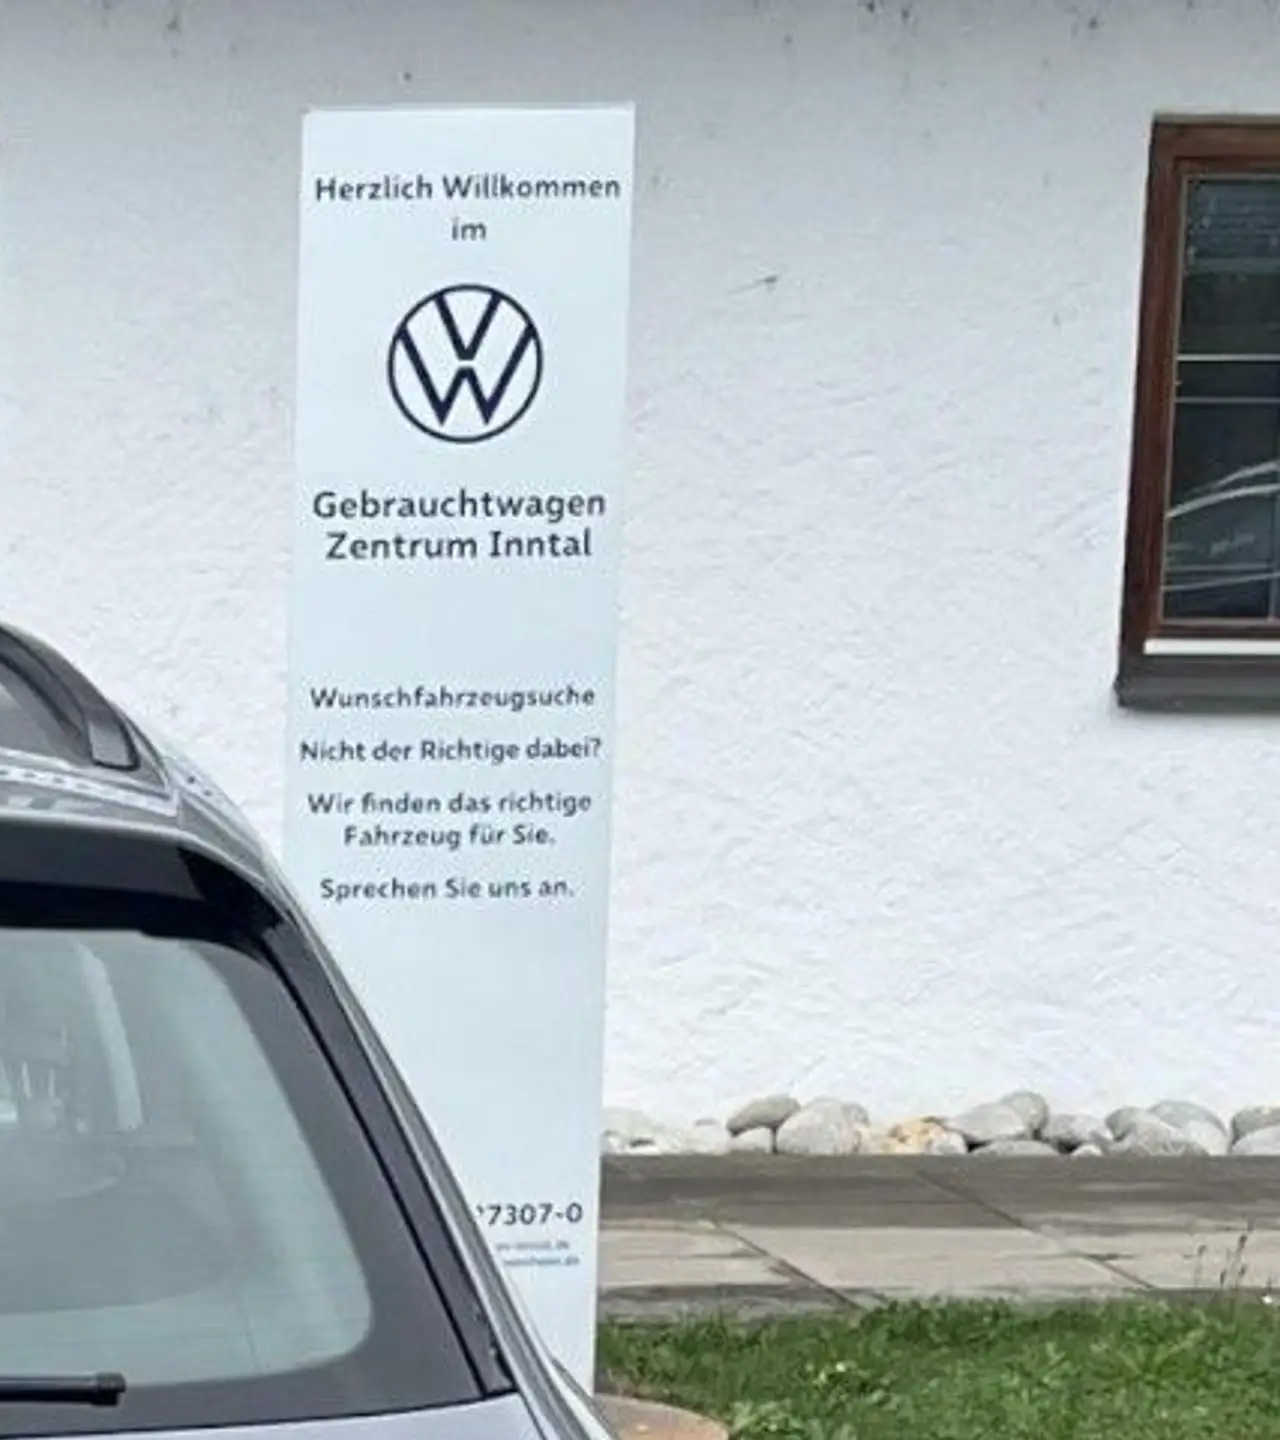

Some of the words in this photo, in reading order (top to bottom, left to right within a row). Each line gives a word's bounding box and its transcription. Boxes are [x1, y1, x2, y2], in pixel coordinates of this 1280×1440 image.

[315, 174, 433, 200] Herzlich
[443, 174, 621, 199] Willkommen
[451, 219, 488, 242] im
[313, 488, 606, 522] Gebrauchtwagen
[325, 530, 479, 560] Zentrum
[488, 528, 593, 558] Inntal
[310, 685, 596, 712] Wunschfahrzeugsuche
[300, 739, 366, 762] Nicht
[371, 739, 414, 761] der
[420, 737, 521, 766] Richtige
[525, 736, 603, 760] dabei?
[307, 792, 356, 815] Wir
[361, 792, 442, 814] finden
[447, 792, 493, 814] das
[498, 791, 592, 817] richtige
[343, 824, 463, 850] Fahrzeug
[468, 823, 506, 846] für
[511, 824, 557, 846] Sie.
[319, 877, 438, 901] Sprechen
[443, 877, 482, 899] Sie
[487, 881, 533, 899] uns
[538, 881, 576, 899] an.
[476, 1202, 584, 1226] 7307-0
